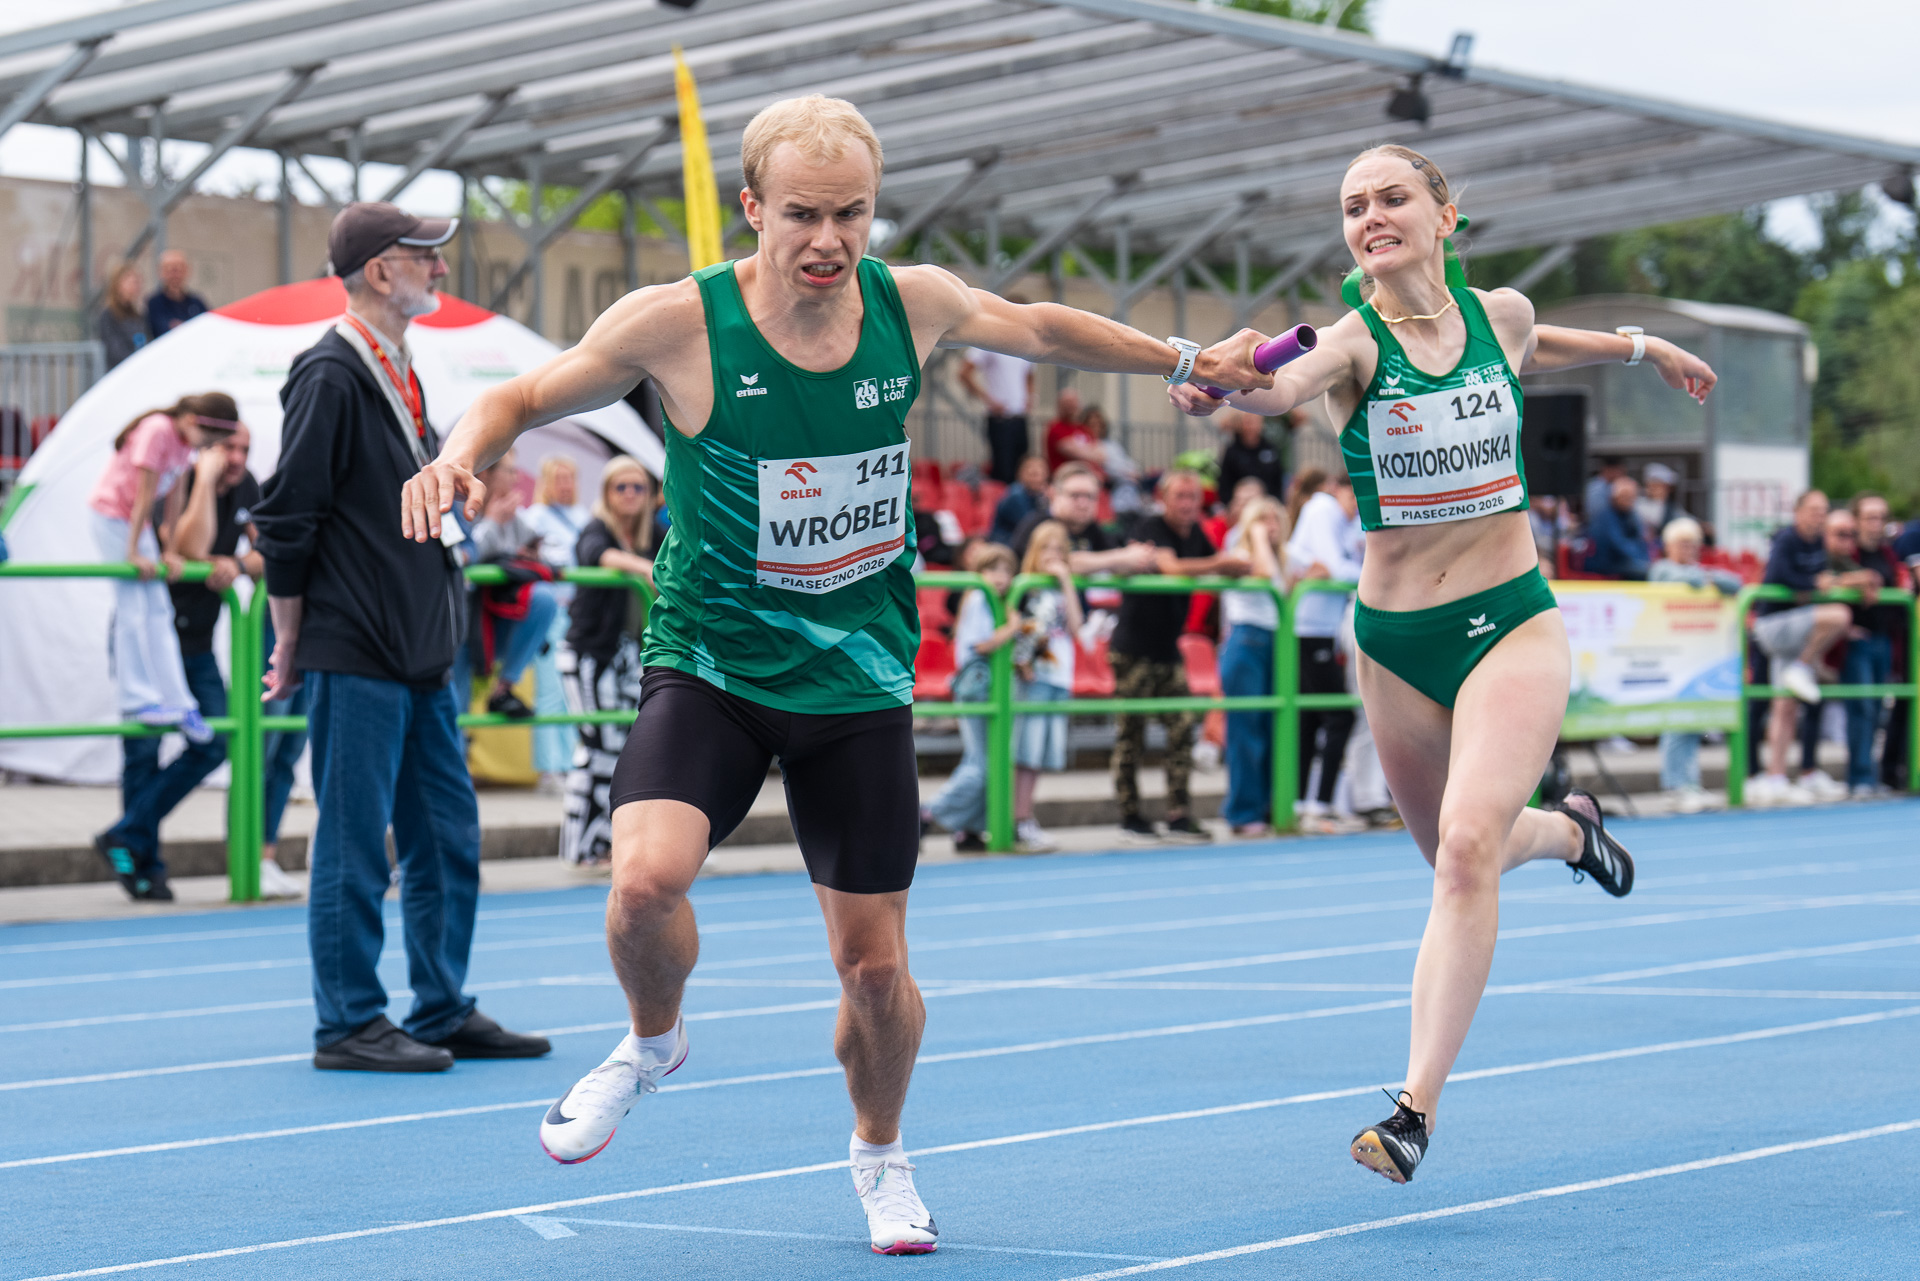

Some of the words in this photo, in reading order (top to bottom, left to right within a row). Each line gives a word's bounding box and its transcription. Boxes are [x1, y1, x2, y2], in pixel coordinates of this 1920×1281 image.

[736, 387, 767, 398] erima
[1379, 386, 1406, 396] erima
[1450, 389, 1503, 421] 124
[1386, 424, 1423, 436] ORLEN
[856, 450, 905, 485] 141
[1377, 434, 1512, 479] KOZIOROWSKA
[780, 487, 822, 500] ORLEN
[1401, 503, 1476, 520] PIASECZNO
[1478, 495, 1504, 511] 2026
[769, 496, 900, 547] WRÓBEL
[781, 567, 855, 589] PIASECZNO
[857, 557, 885, 575] 2026
[1467, 622, 1497, 638] erima
